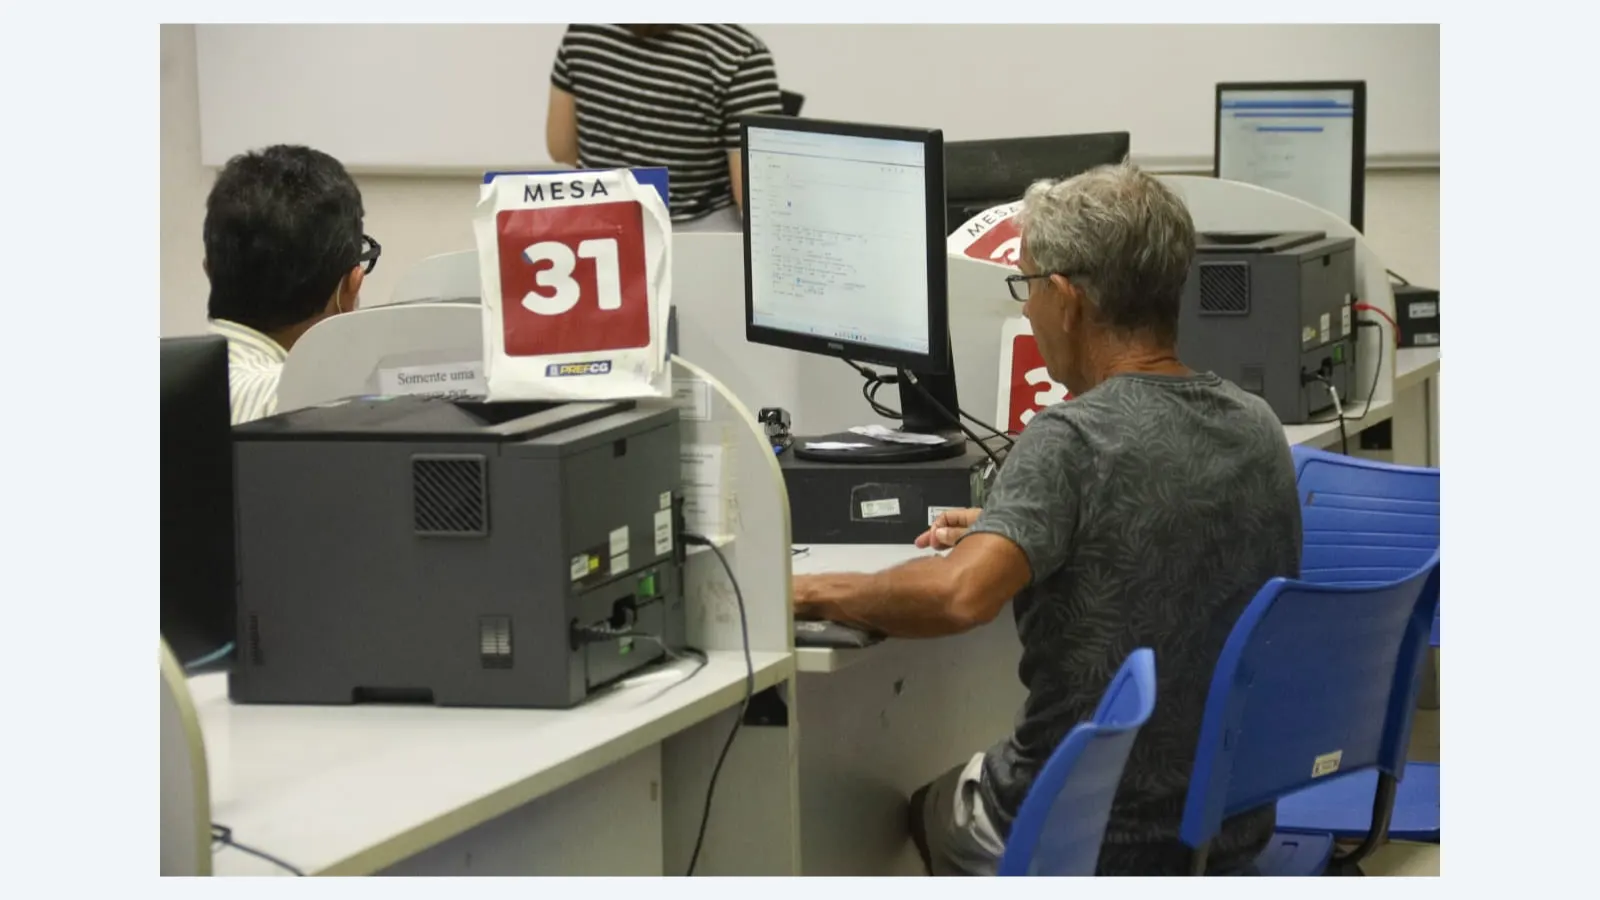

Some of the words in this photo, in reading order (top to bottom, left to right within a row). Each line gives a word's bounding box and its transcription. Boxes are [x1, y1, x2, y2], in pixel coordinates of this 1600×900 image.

[523, 179, 609, 202] MESA
[521, 238, 622, 316] 31
[397, 372, 447, 386] Somente
[449, 369, 476, 381] uma
[560, 362, 609, 374] PREFCG
